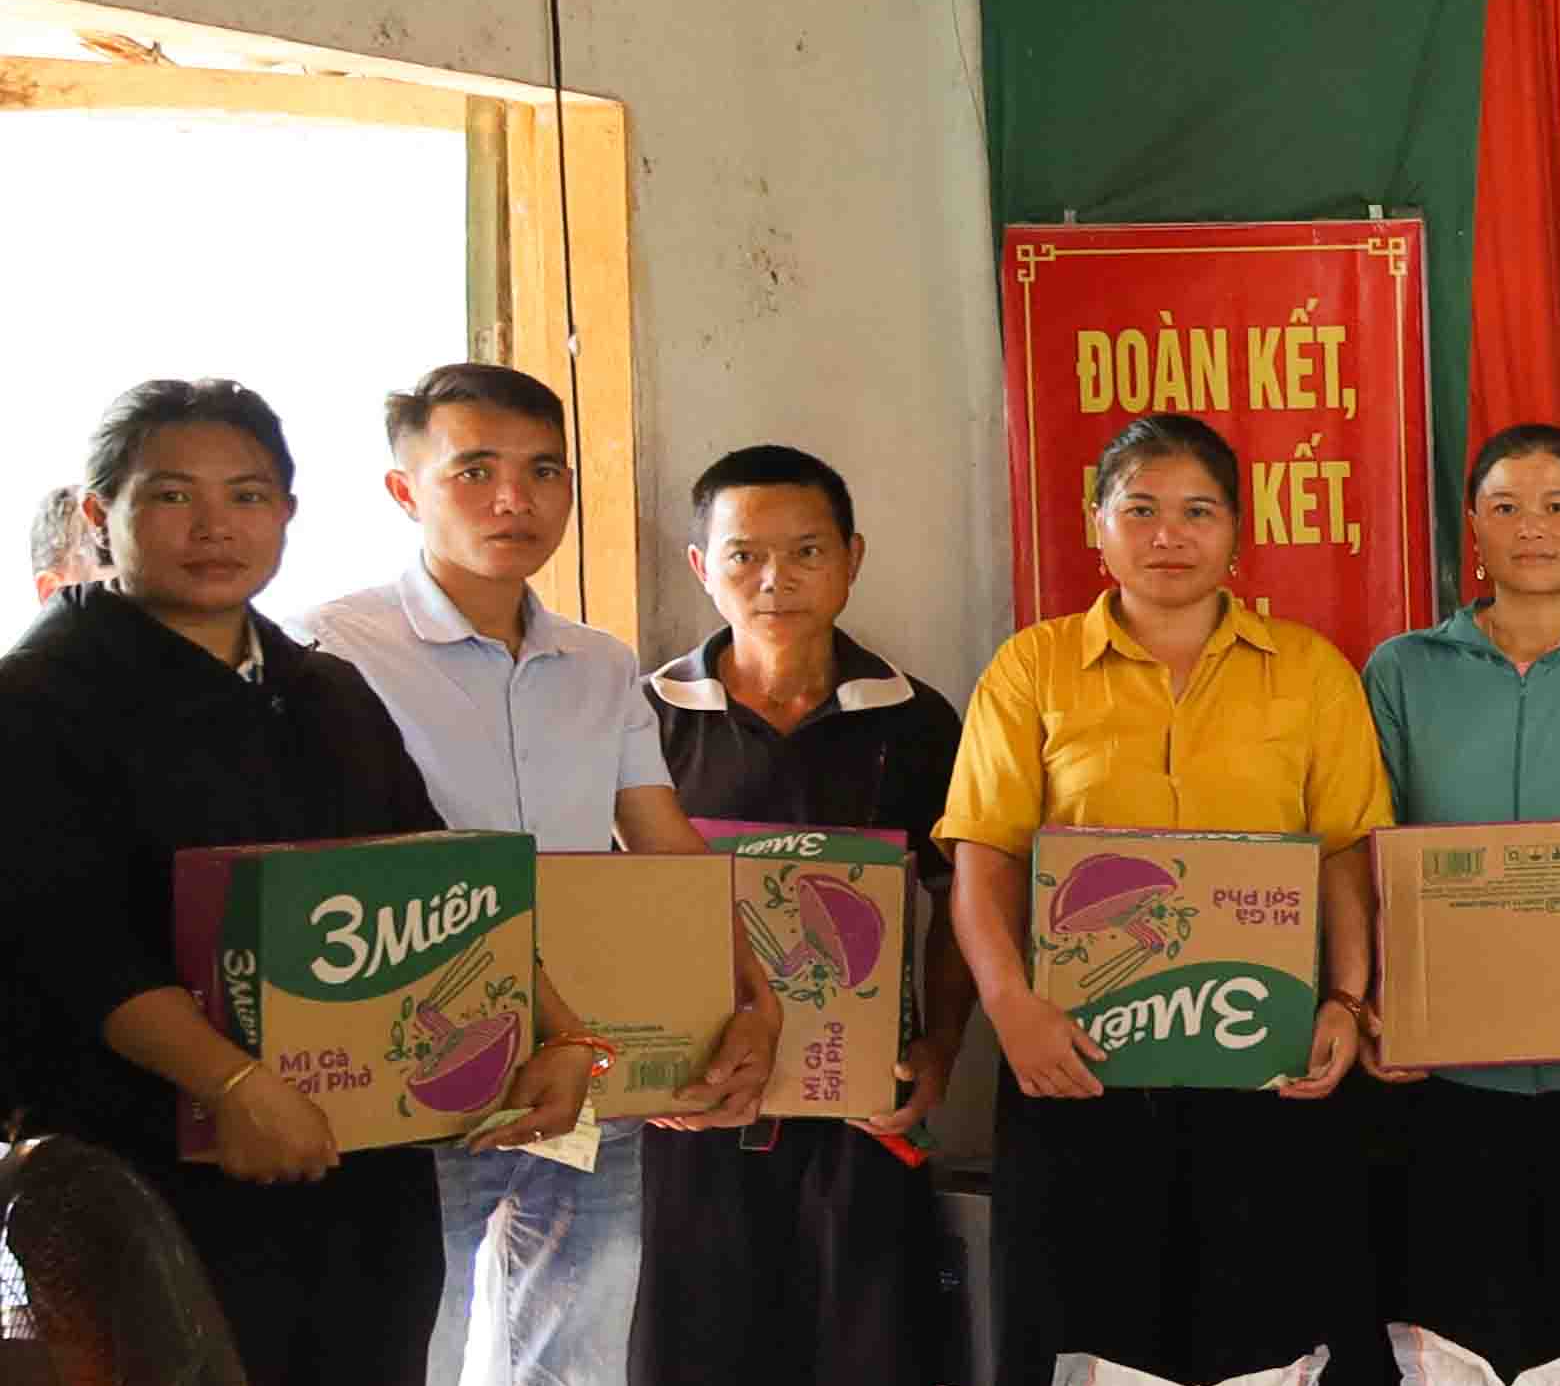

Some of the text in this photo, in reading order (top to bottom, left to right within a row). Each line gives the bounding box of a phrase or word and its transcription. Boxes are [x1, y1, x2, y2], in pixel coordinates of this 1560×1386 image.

[1076, 298, 1356, 420] ĐOÀN KẾT,
[1253, 433, 1361, 555] KẾT,
